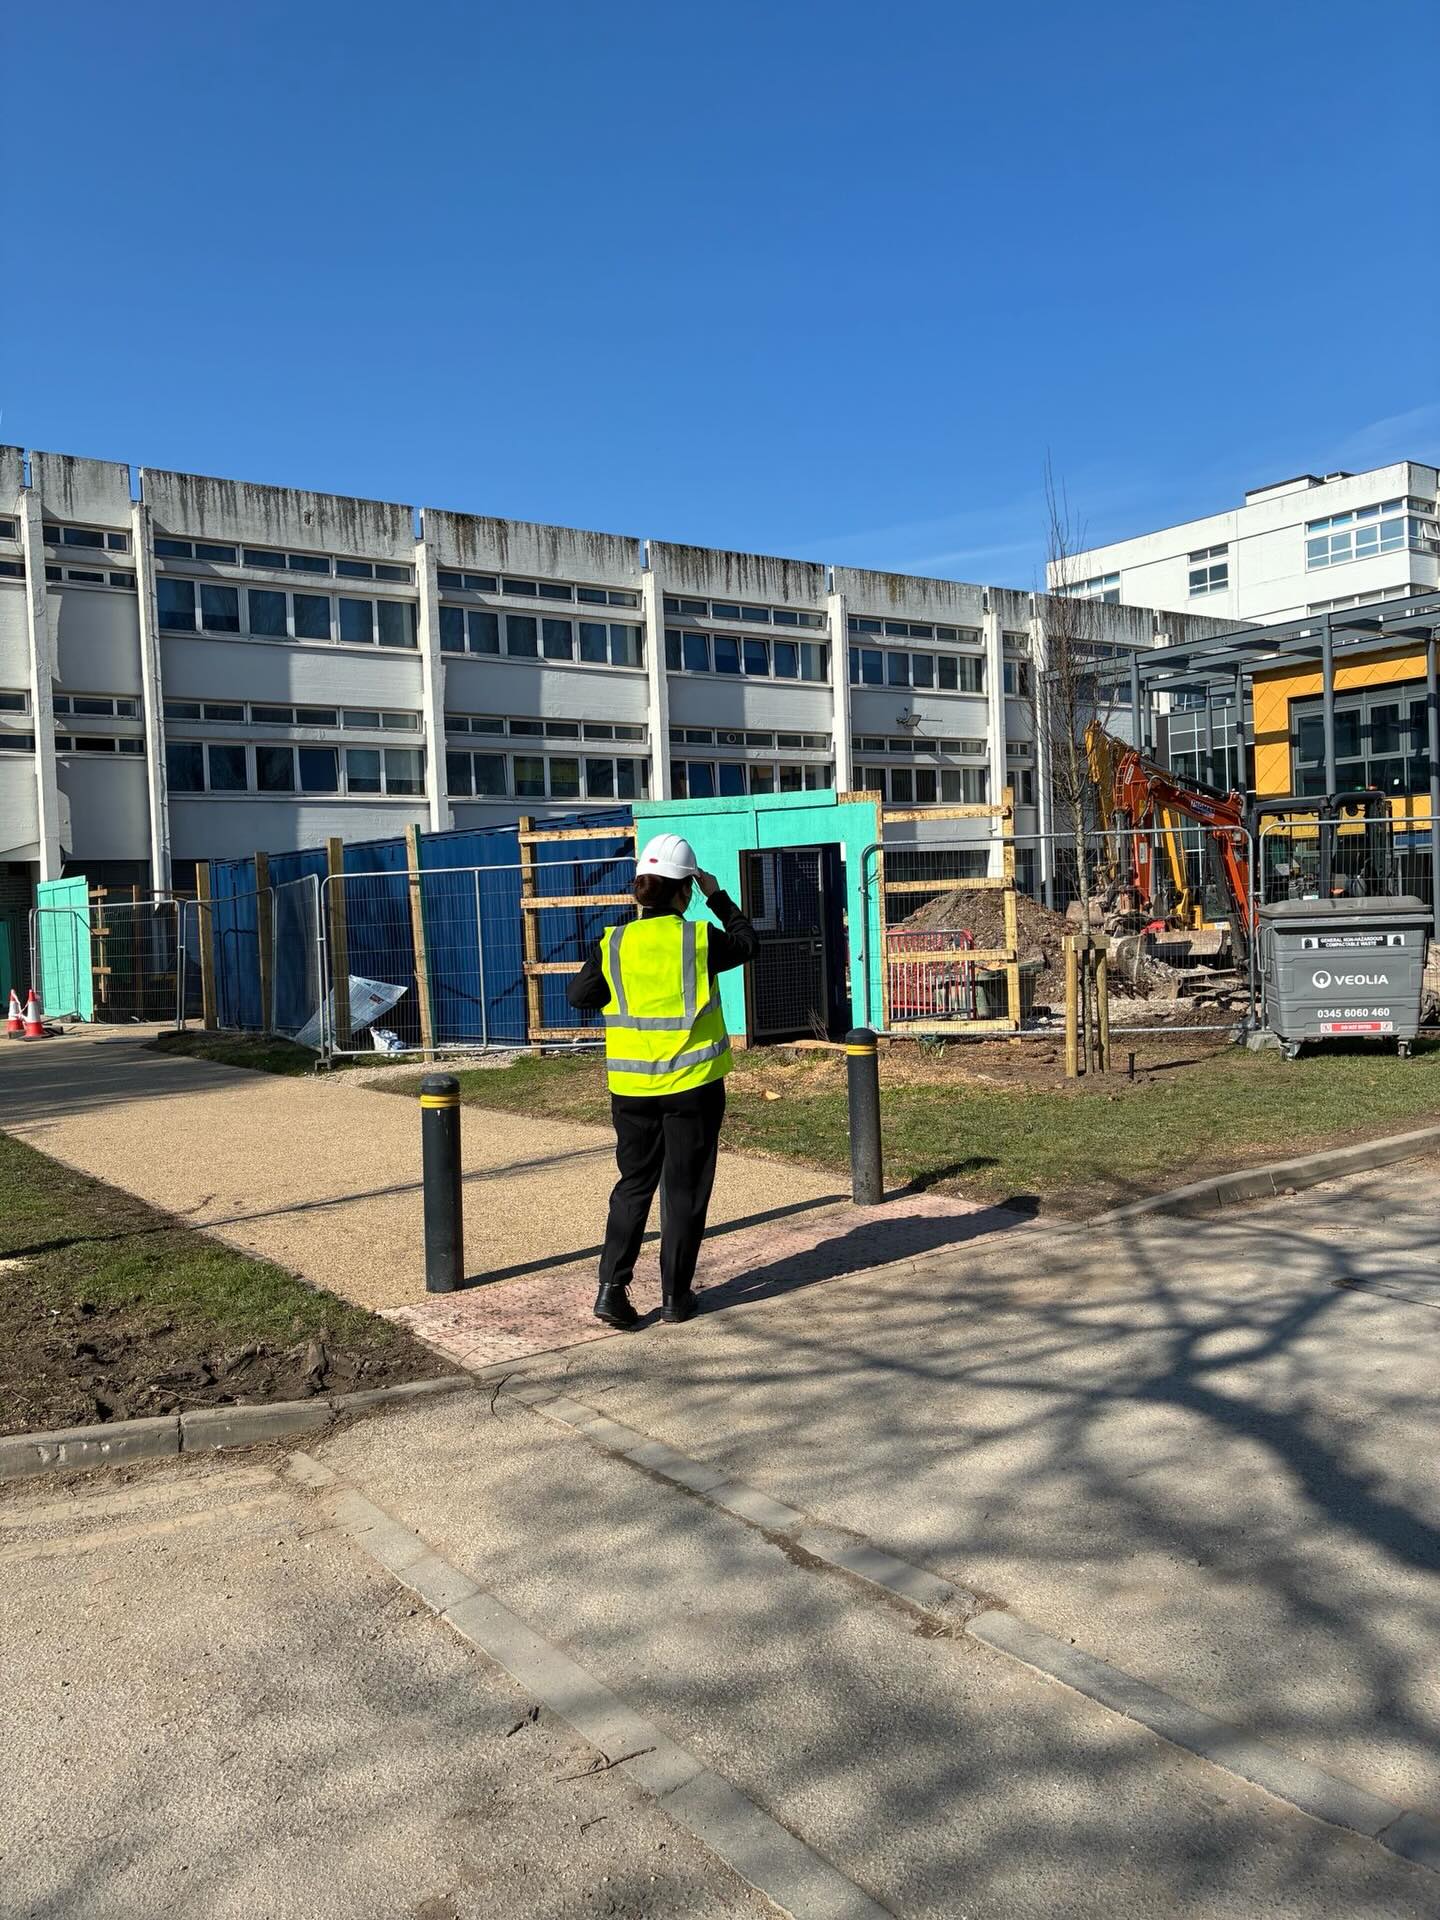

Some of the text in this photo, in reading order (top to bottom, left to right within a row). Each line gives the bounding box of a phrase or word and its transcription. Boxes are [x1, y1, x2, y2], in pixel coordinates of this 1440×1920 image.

[1334, 974, 1388, 985] VEOLIA
[1317, 1008, 1390, 1018] 0345 6060 460
